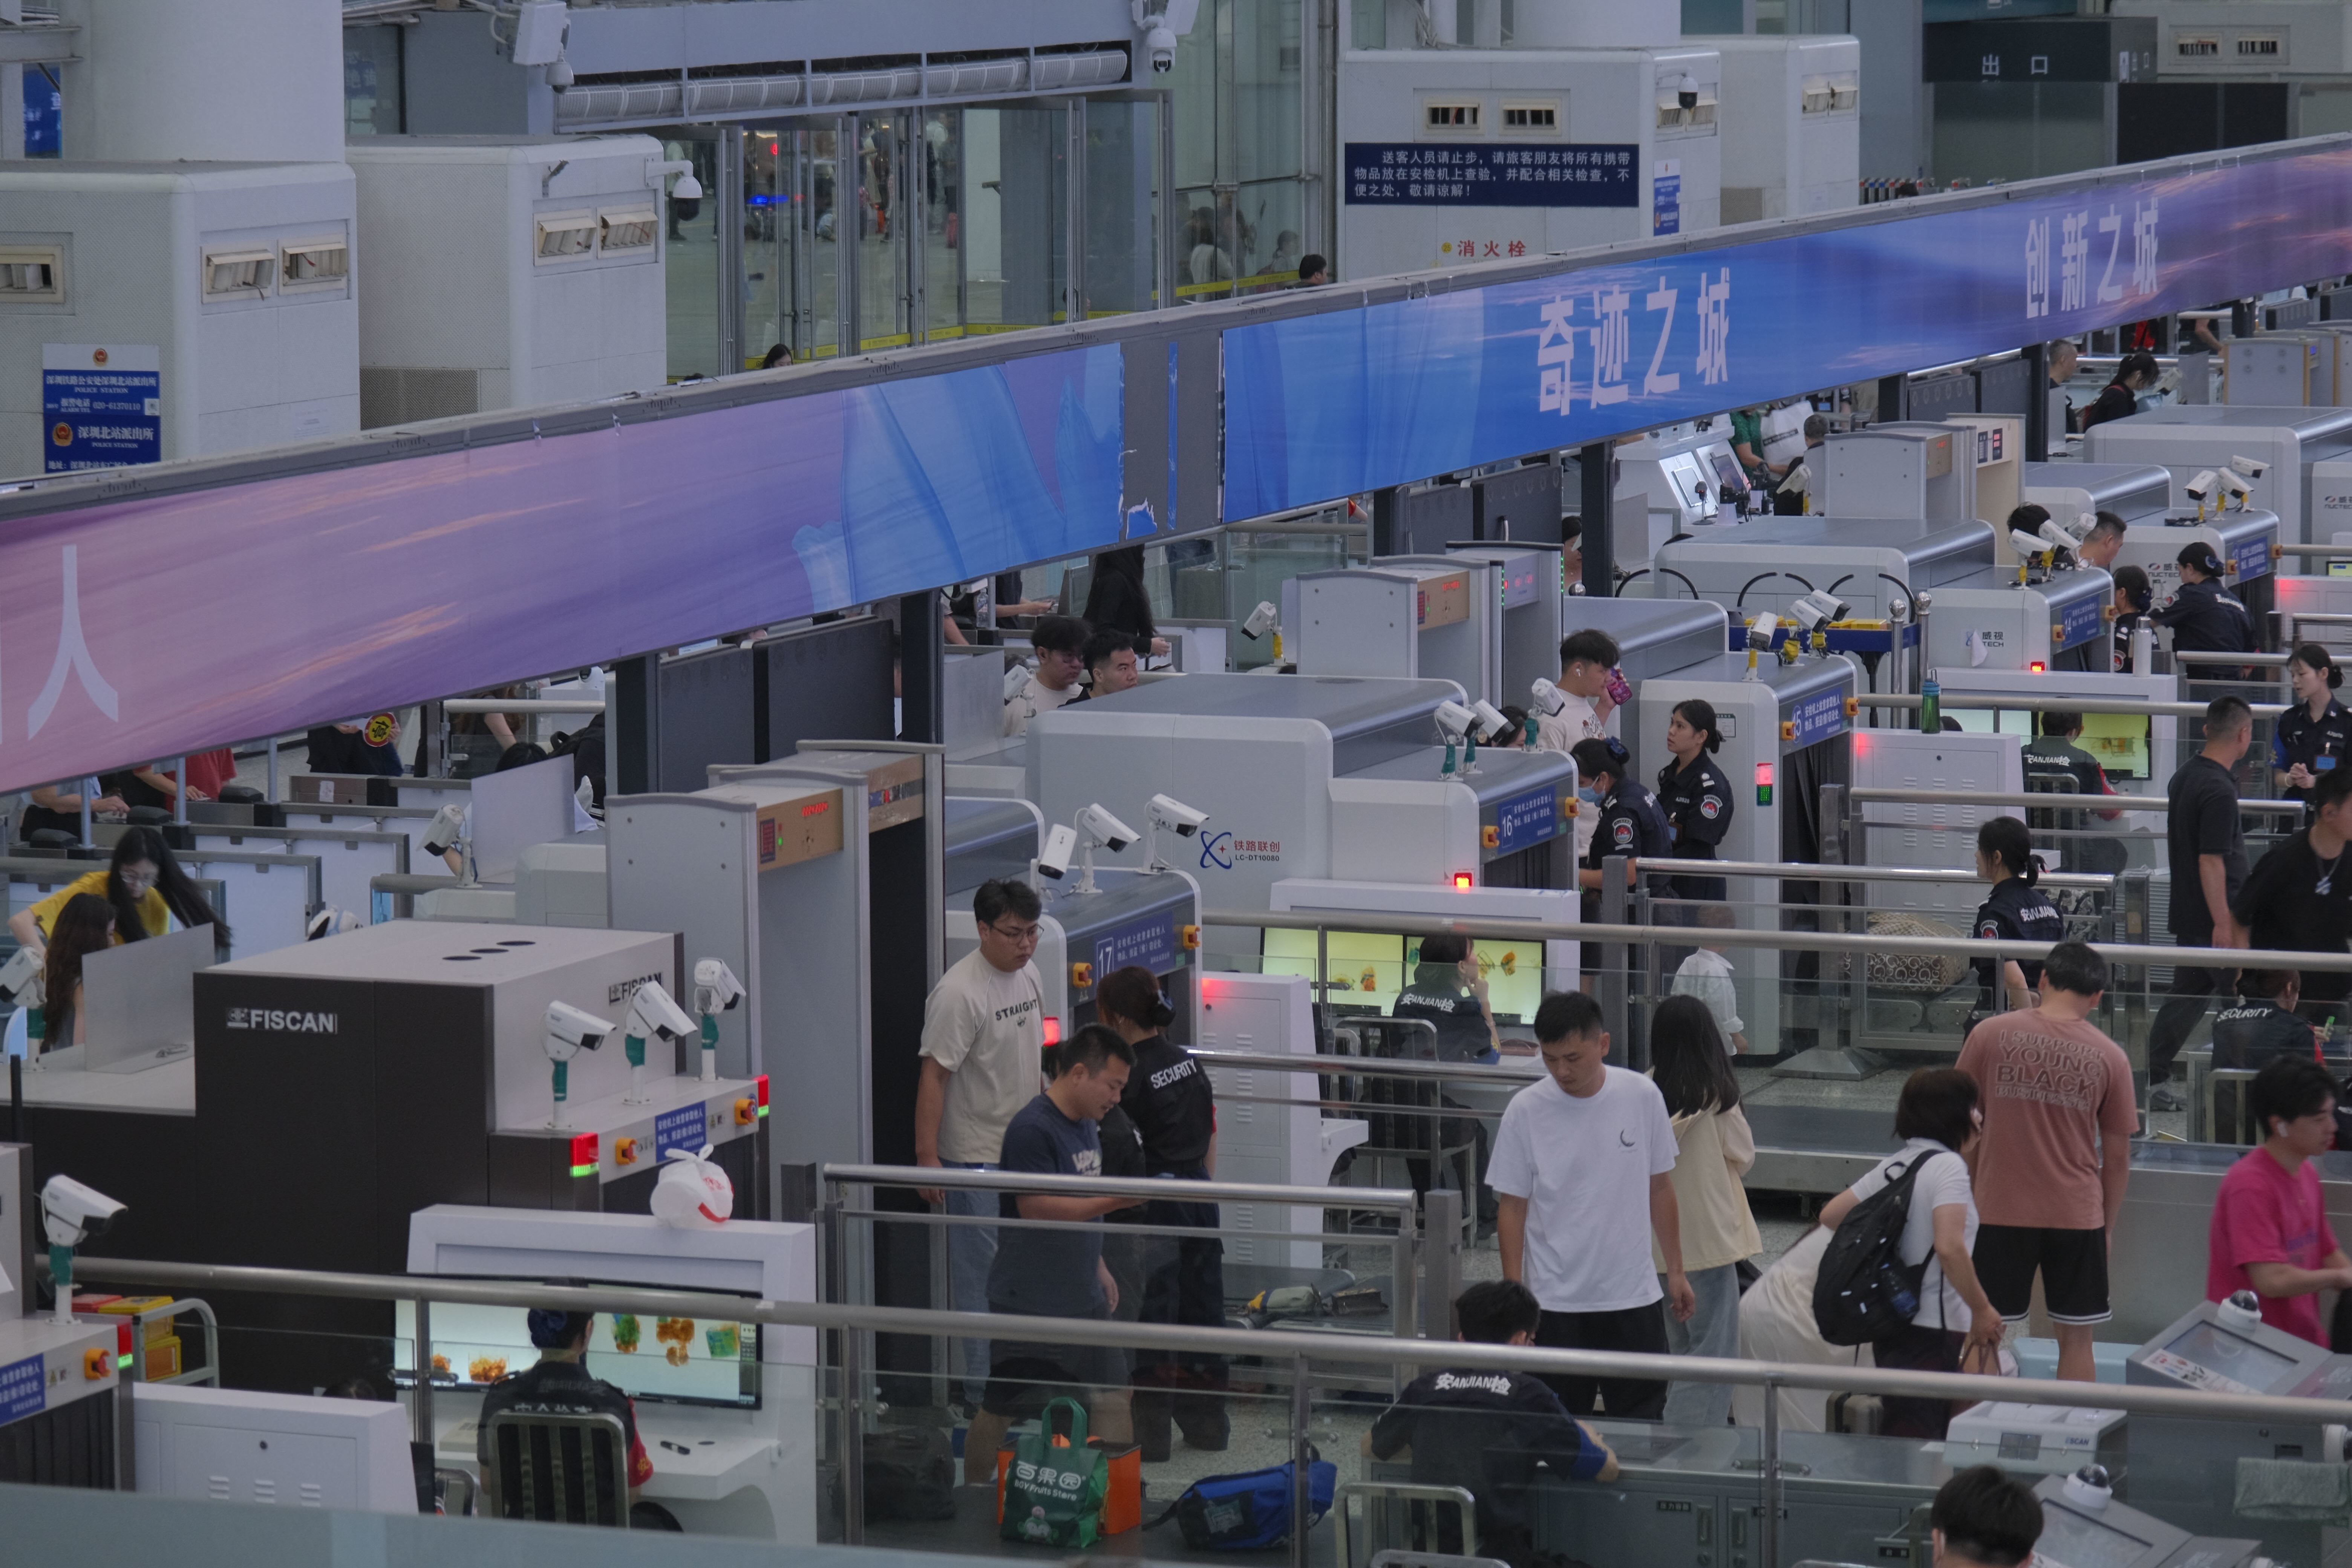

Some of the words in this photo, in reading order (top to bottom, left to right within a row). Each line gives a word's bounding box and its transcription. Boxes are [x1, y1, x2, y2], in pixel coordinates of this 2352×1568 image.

[1982, 54, 2048, 75] 出口
[1382, 151, 1631, 165] 送客人员请止步，请旅客朋友将所有携带
[1354, 167, 1630, 182] 物品放在安检机上查验，并配合相关检查，不
[1355, 184, 1471, 197] 便之处，敬请谅解！
[1458, 239, 1526, 257] 消火栓
[2025, 197, 2159, 319] 创新之城
[1537, 267, 1730, 416] 奇迹之城
[78, 426, 154, 440] 深圳北站派出所
[1982, 631, 2003, 640] 威视
[2065, 617, 2072, 635] 14
[372, 720, 390, 739] 停
[1502, 814, 1512, 838] 16
[1234, 836, 1280, 853] 铁路联创
[1099, 946, 1112, 978] 17
[250, 1009, 334, 1033] FISCAN
[995, 999, 1037, 1021] STRAIGHT
[2217, 1008, 2273, 1023] SECURITY
[2012, 1031, 2105, 1060] SUPPORT
[2000, 1044, 2102, 1080] YOUNG
[1151, 1058, 1197, 1089] SECURITY
[1997, 1064, 2097, 1097] BLACK
[1017, 1461, 1082, 1490] 百果园
[1014, 1479, 1029, 1490] BGY
[1029, 1484, 1052, 1496] Fruits
[1052, 1489, 1077, 1501] Store
